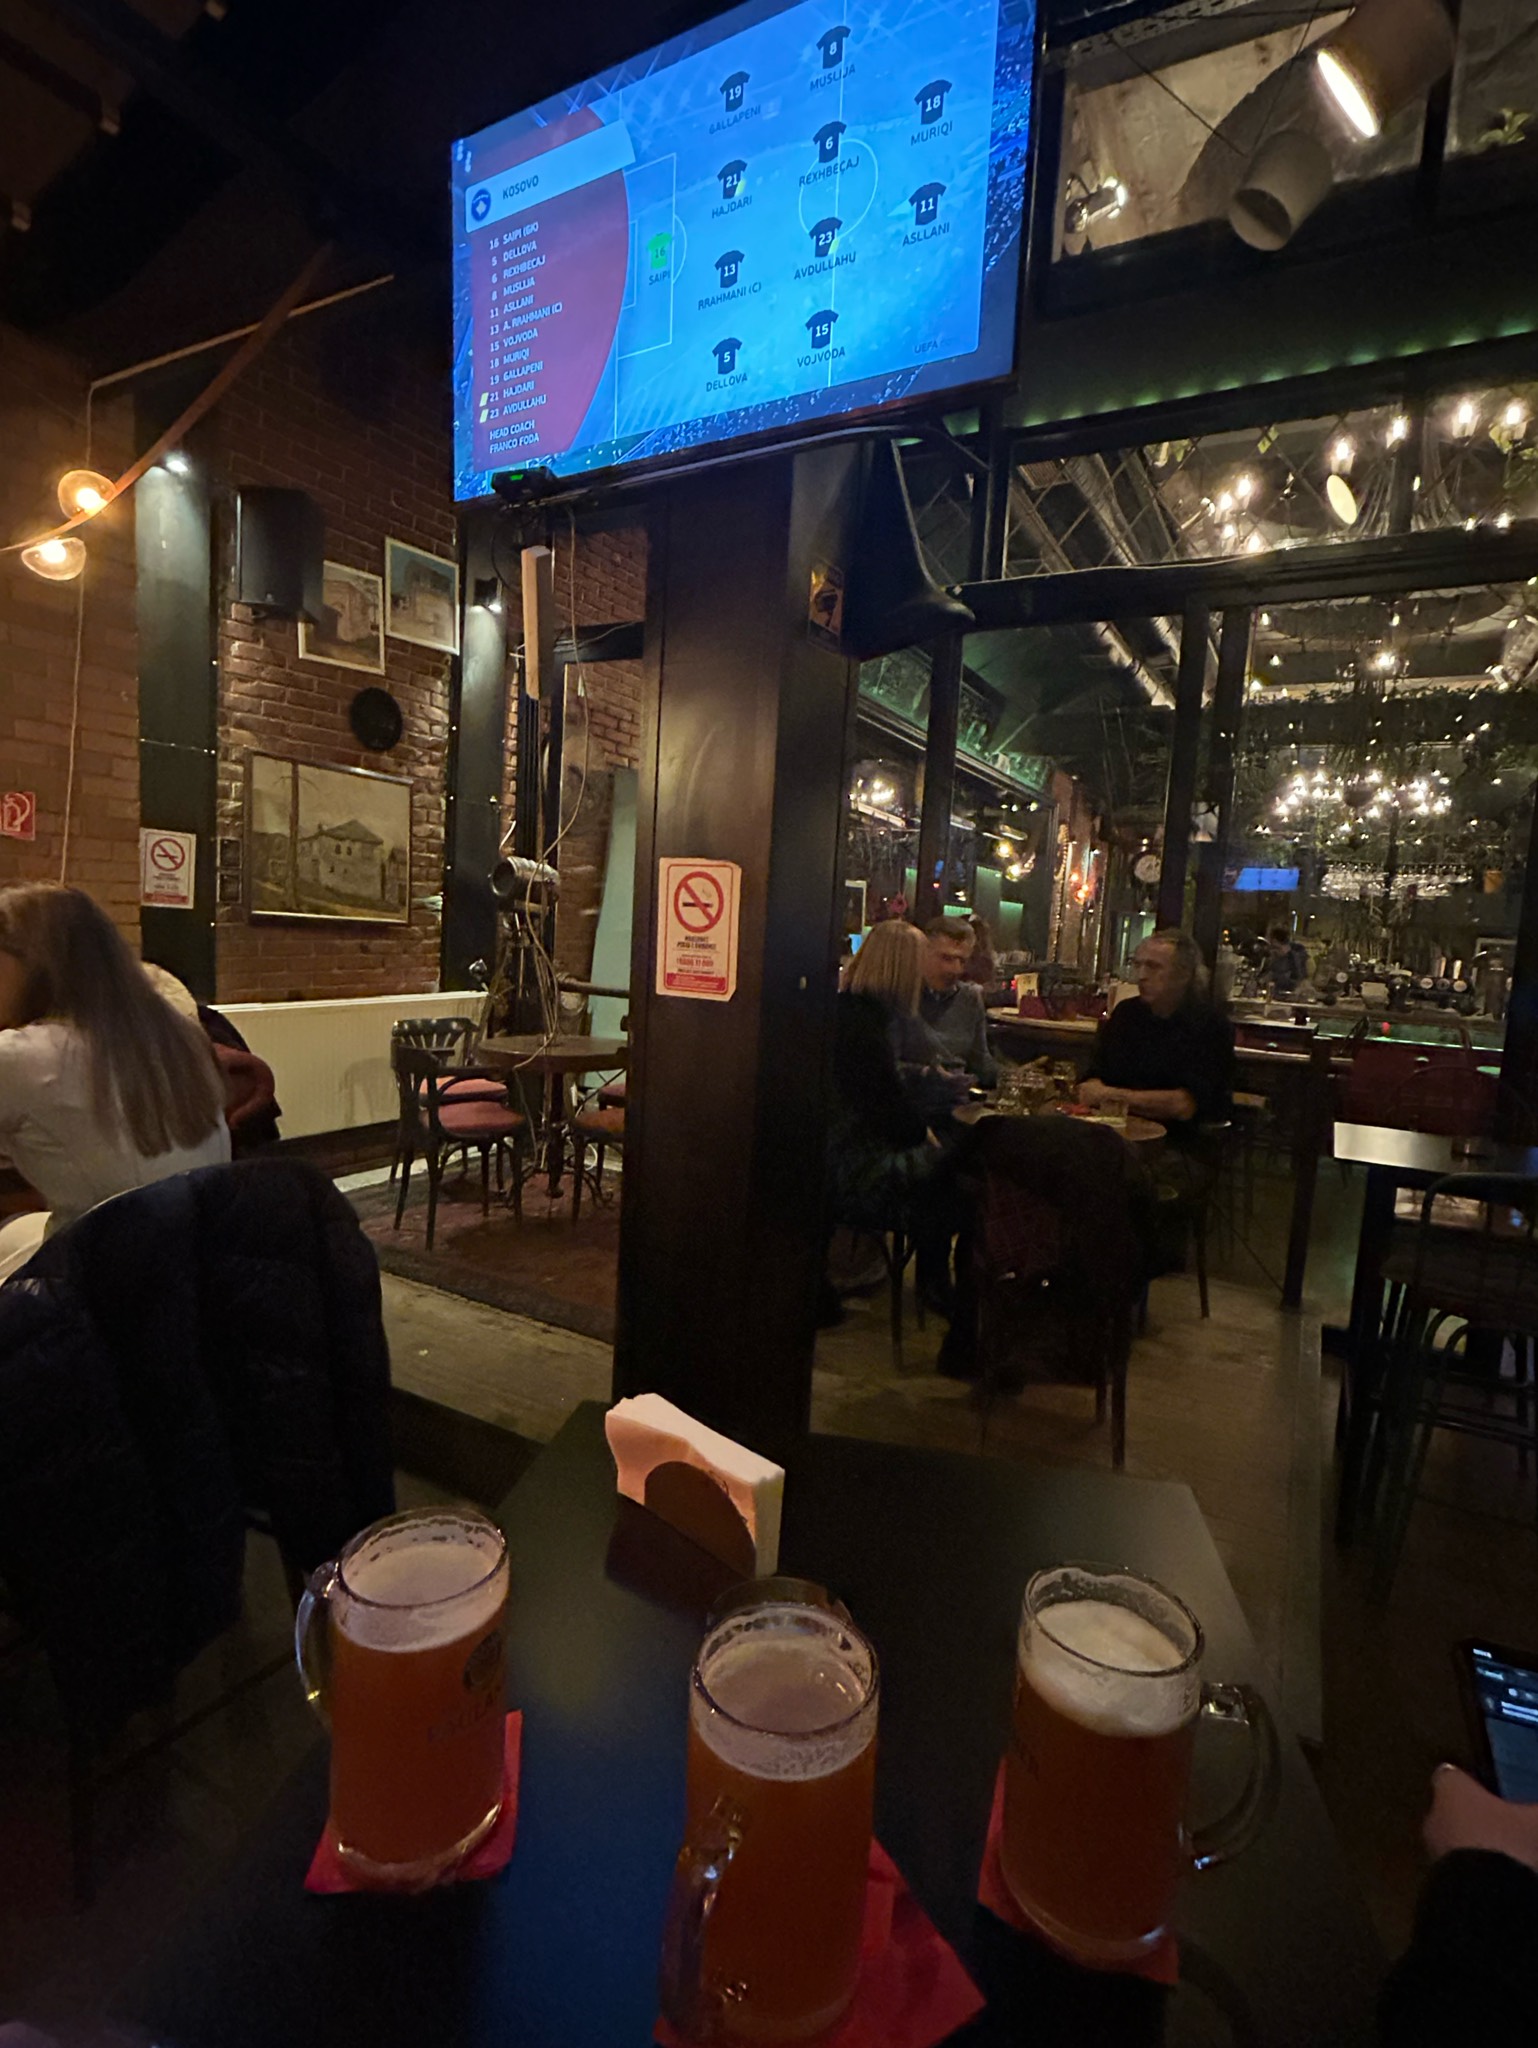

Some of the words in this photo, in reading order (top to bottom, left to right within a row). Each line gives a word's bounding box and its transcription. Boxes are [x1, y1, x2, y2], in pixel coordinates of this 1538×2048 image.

[829, 42, 837, 56] 8
[810, 64, 856, 91] MUSLIJA
[728, 86, 742, 100] 19
[925, 95, 941, 112] 18
[709, 105, 761, 134] GALLAPENI
[826, 136, 834, 149] 6
[910, 122, 953, 146] MURIQI
[725, 175, 738, 188] 21
[799, 155, 859, 187] REXHBEÇAJ
[503, 175, 539, 200] KOSOVO
[711, 196, 752, 218] HAJDARI
[920, 198, 935, 213] 11
[489, 238, 499, 250] 16
[503, 229, 522, 245] SAIPI
[818, 232, 832, 245] 23
[902, 224, 950, 247] ASLLANI
[492, 256, 497, 266] 5
[503, 240, 537, 262] DELLOVA
[655, 246, 666, 259] 16
[724, 264, 736, 277] 13
[794, 251, 856, 280] AVDULLAHU
[492, 274, 497, 284] 6
[503, 277, 535, 296] MUSLIJA
[649, 270, 670, 285] SAIPI
[490, 308, 499, 318] 11
[503, 294, 534, 314] ASLLANI
[698, 286, 747, 310] RRAHMANI
[749, 281, 762, 295] (C)
[490, 324, 499, 335] 13
[503, 320, 510, 331] A.
[512, 306, 550, 328] RRAHMANI
[551, 302, 563, 314] (C)
[490, 341, 499, 352] 15
[503, 328, 538, 347] VOJVODA
[815, 324, 829, 338] 15
[724, 352, 731, 363] 5
[797, 347, 846, 368] VOJVODA
[914, 340, 938, 354] UEFA
[490, 358, 499, 369] 18
[503, 348, 529, 364] MURIQI
[490, 375, 499, 386] 19
[503, 361, 543, 381] GALLAPENI
[706, 373, 748, 392] DELLOVA
[489, 392, 499, 402] 21
[503, 381, 534, 398] HAJDARI
[490, 408, 499, 419] 23
[503, 394, 546, 416] AVDULLAHU
[490, 426, 509, 440] HEAD
[510, 420, 535, 435] COACH
[490, 437, 518, 454] FRANCO
[519, 433, 539, 446] FODA
